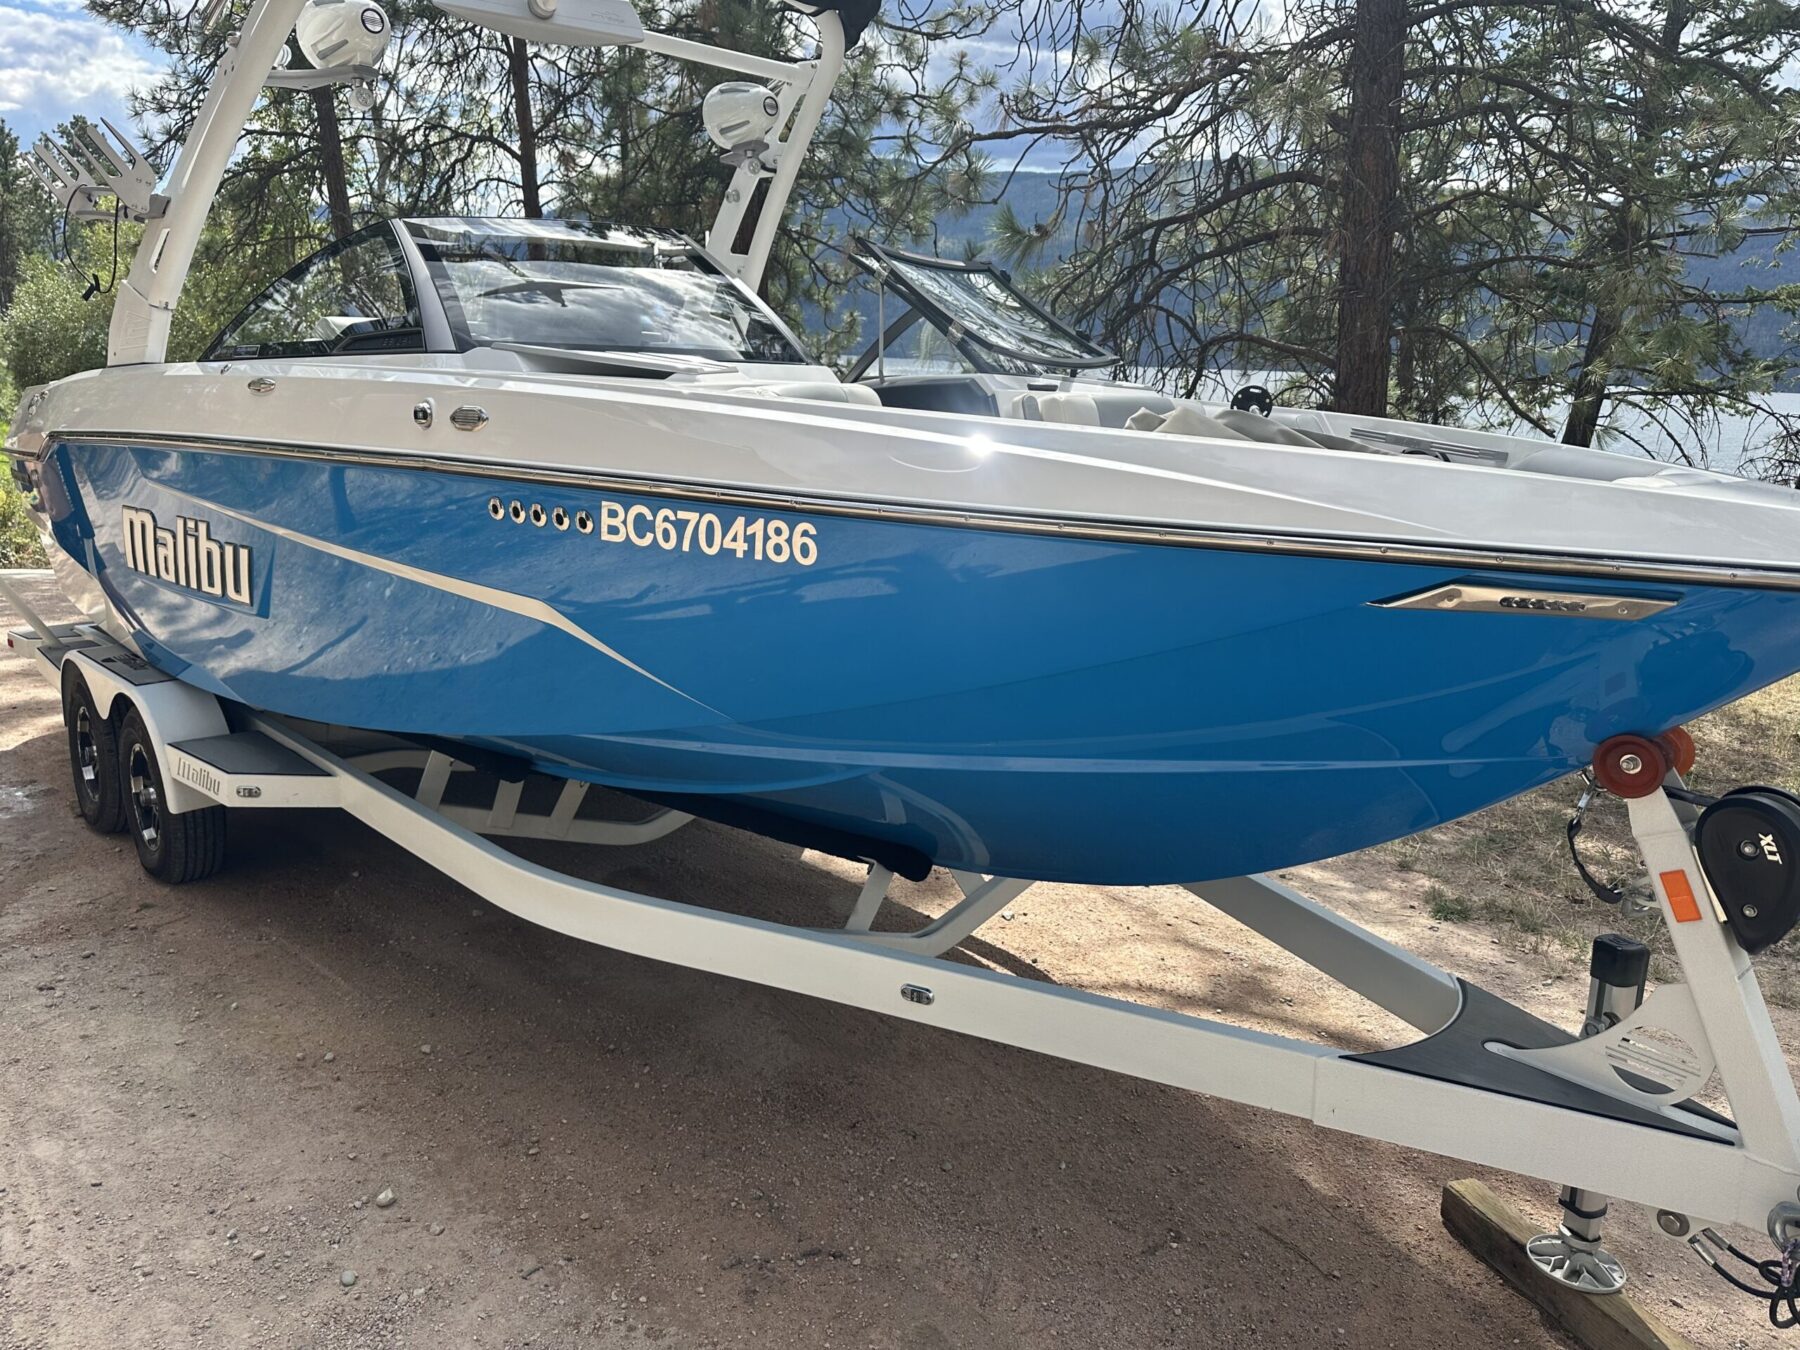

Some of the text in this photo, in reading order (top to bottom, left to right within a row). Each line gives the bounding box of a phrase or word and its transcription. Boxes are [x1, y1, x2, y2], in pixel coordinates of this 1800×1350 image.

[122, 505, 253, 607] Malibu
[601, 501, 818, 566] BC6704186
[177, 757, 220, 796] Malibu
[1758, 833, 1783, 865] XLT
